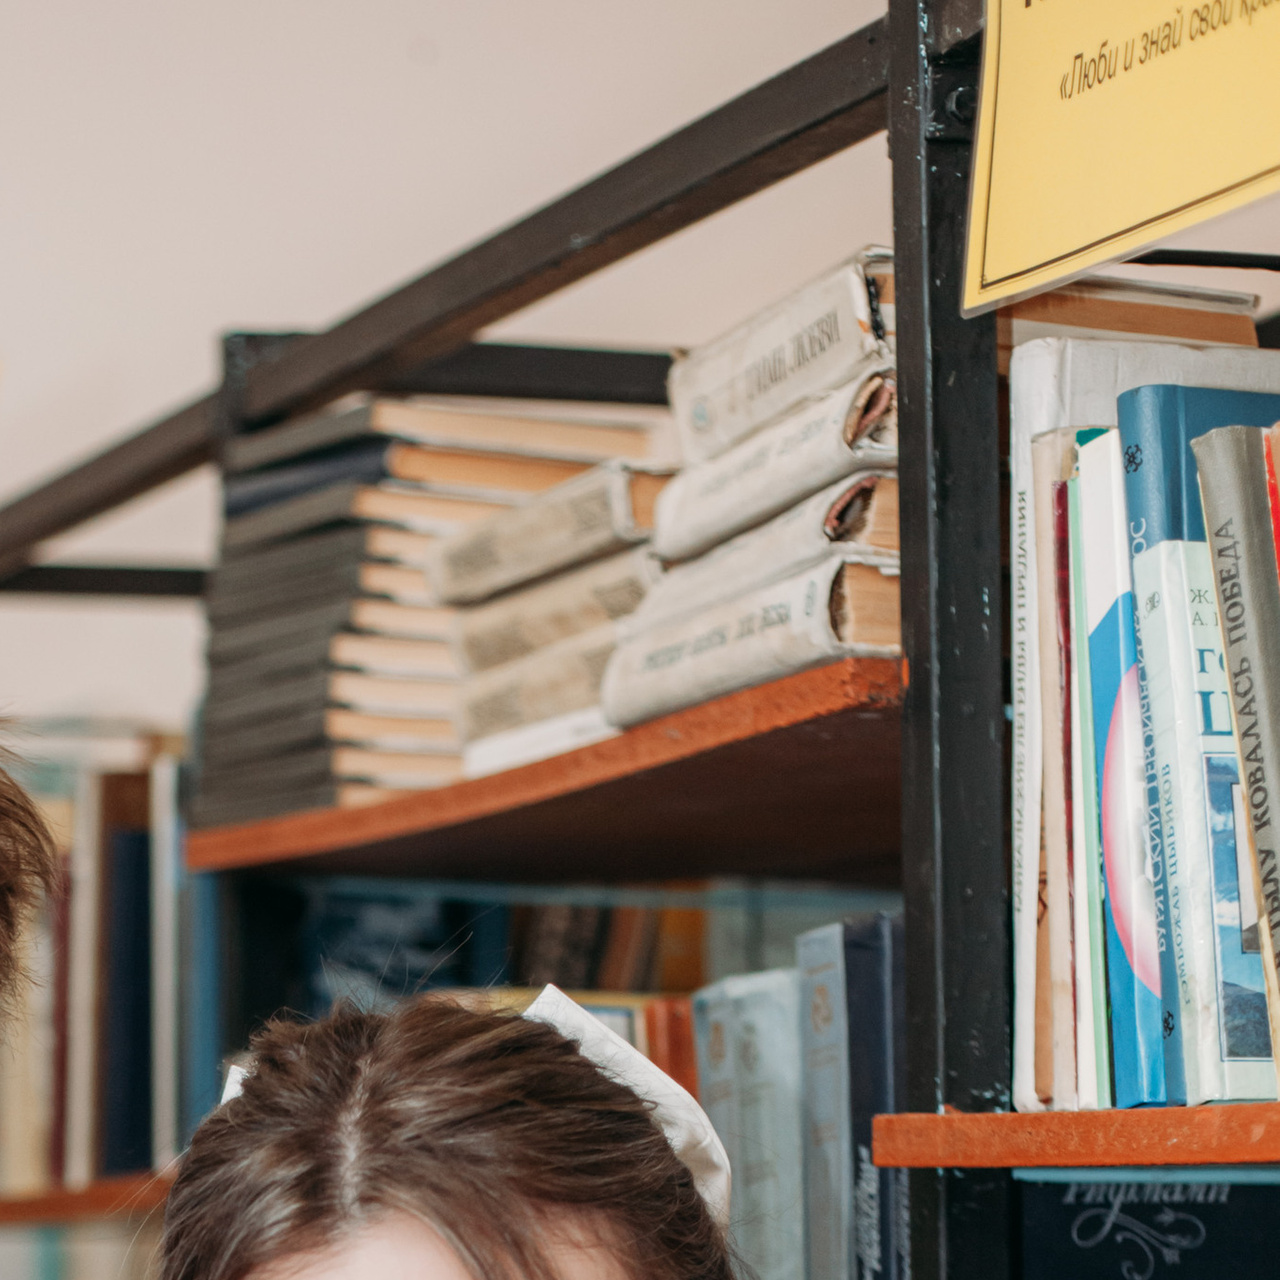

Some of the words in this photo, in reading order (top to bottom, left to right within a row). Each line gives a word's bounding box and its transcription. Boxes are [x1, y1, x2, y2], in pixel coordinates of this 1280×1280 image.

[1059, 39, 1119, 100] «Люби
[1123, 38, 1135, 72] и
[1138, 6, 1184, 65] знай
[1213, 517, 1249, 646] ПОБЕДА
[1233, 656, 1271, 832] КОВАЛАСЬ
